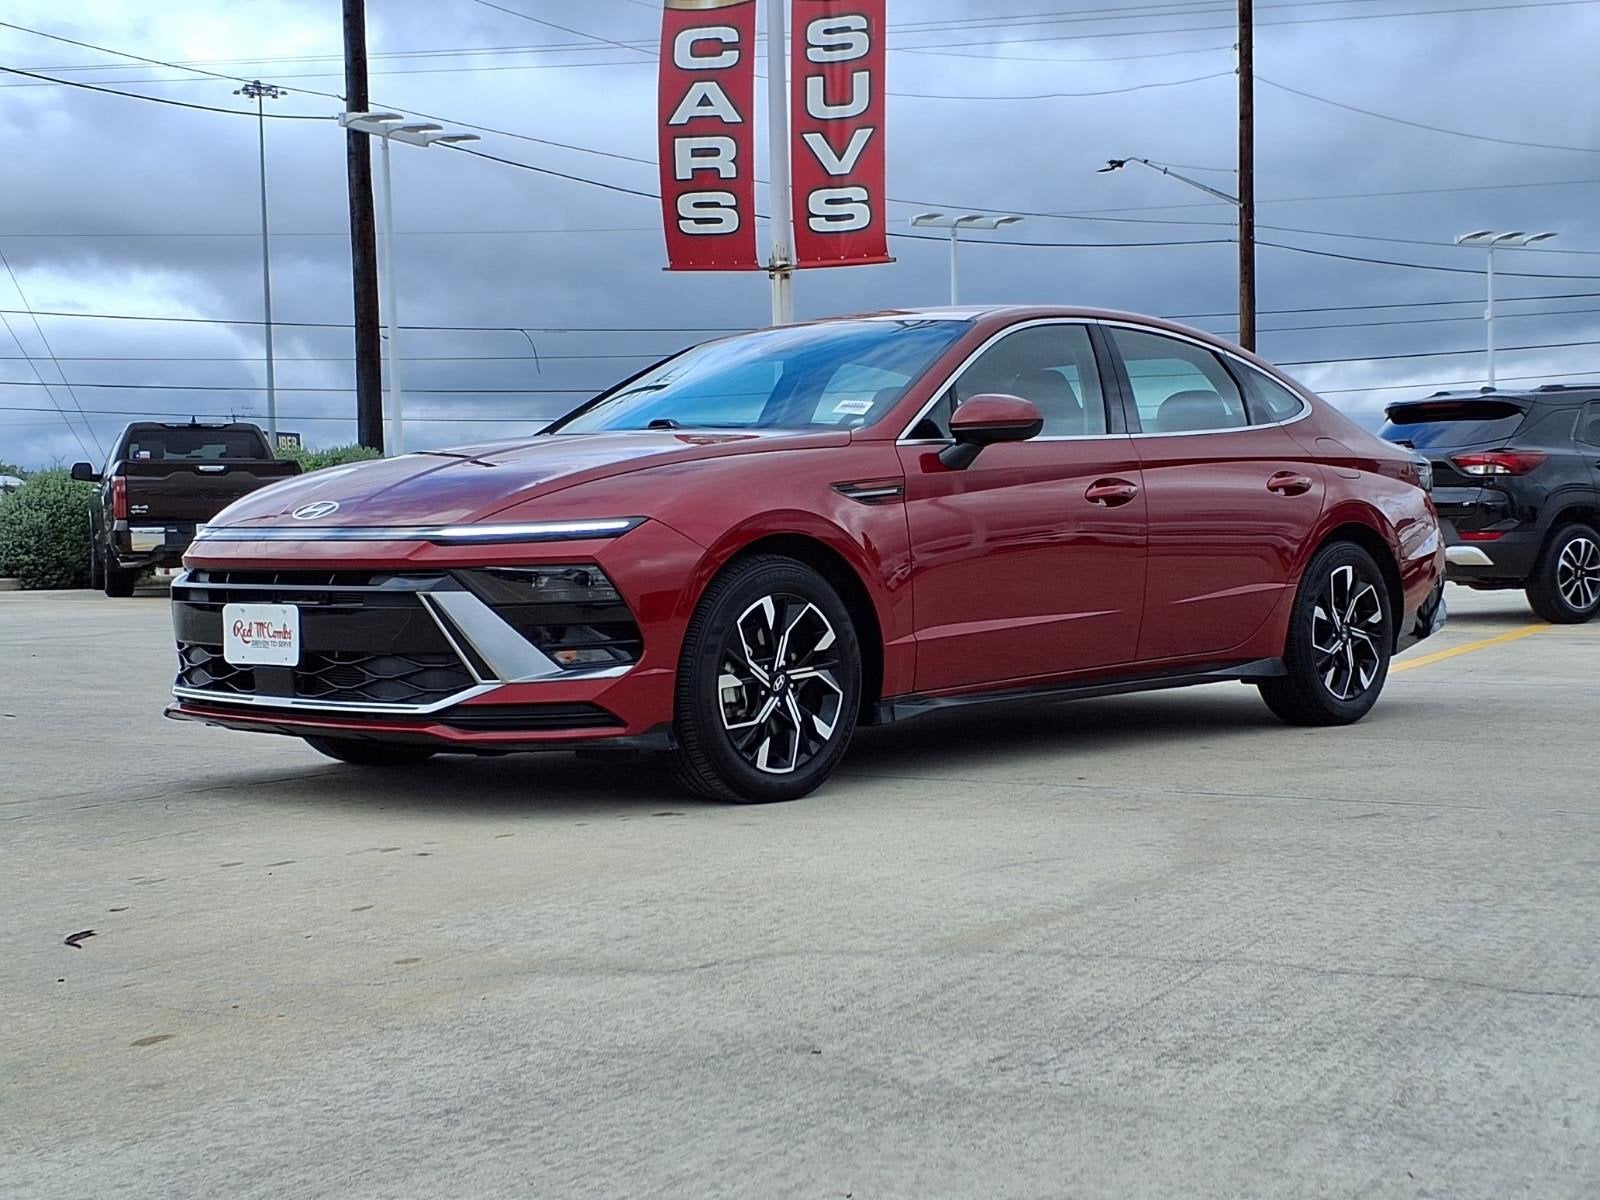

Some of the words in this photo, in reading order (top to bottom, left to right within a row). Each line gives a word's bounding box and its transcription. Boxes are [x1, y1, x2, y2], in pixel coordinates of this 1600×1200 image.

[667, 26, 743, 235] CARS
[802, 14, 875, 234] SUVS
[233, 619, 252, 644] Red
[254, 621, 292, 640] McCombs
